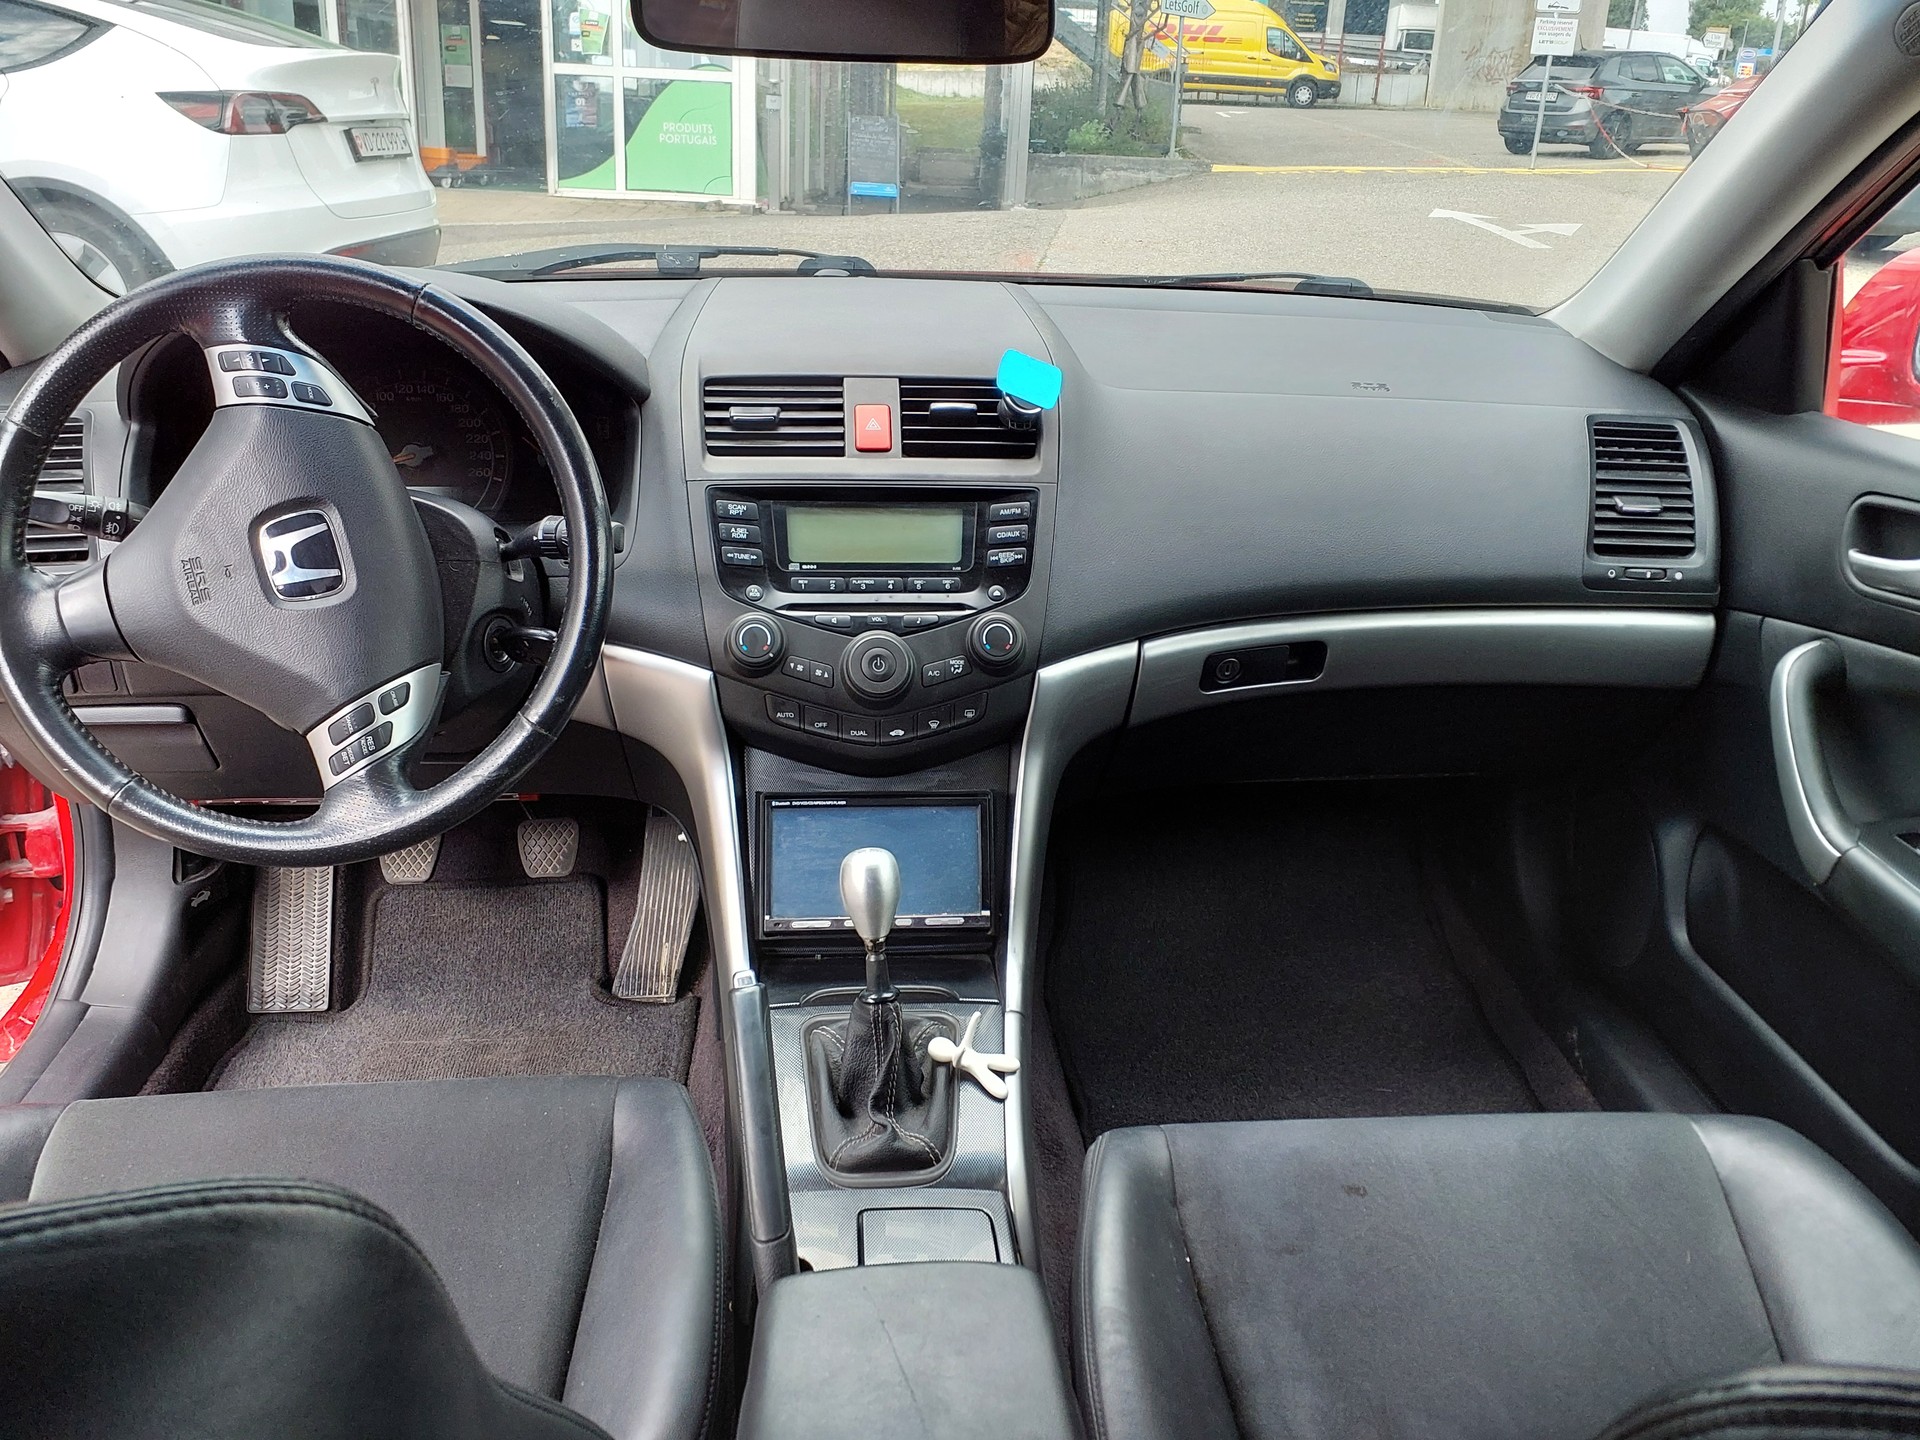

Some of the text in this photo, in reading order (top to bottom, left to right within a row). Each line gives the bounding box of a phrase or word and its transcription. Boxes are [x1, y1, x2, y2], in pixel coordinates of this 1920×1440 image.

[1165, 0, 1200, 14] LetsGolf
[663, 122, 713, 134] PRODUITS
[659, 133, 717, 146] PORTUGAIS
[395, 385, 414, 394] 120
[416, 385, 435, 394] 140
[376, 392, 394, 401] 100
[436, 392, 454, 402] 160
[451, 404, 470, 413] 180
[459, 418, 481, 428] 200
[466, 433, 489, 444] 220
[469, 451, 492, 461] 240
[468, 467, 491, 477] 260
[68, 503, 85, 512] OFF
[727, 503, 747, 511] SCAN
[996, 530, 1021, 539] CD/AUX
[734, 552, 751, 560] TUNE
[180, 559, 202, 607] AIRBAG
[191, 556, 211, 603] SRS
[366, 735, 376, 751] RES
[341, 752, 351, 766] SET
